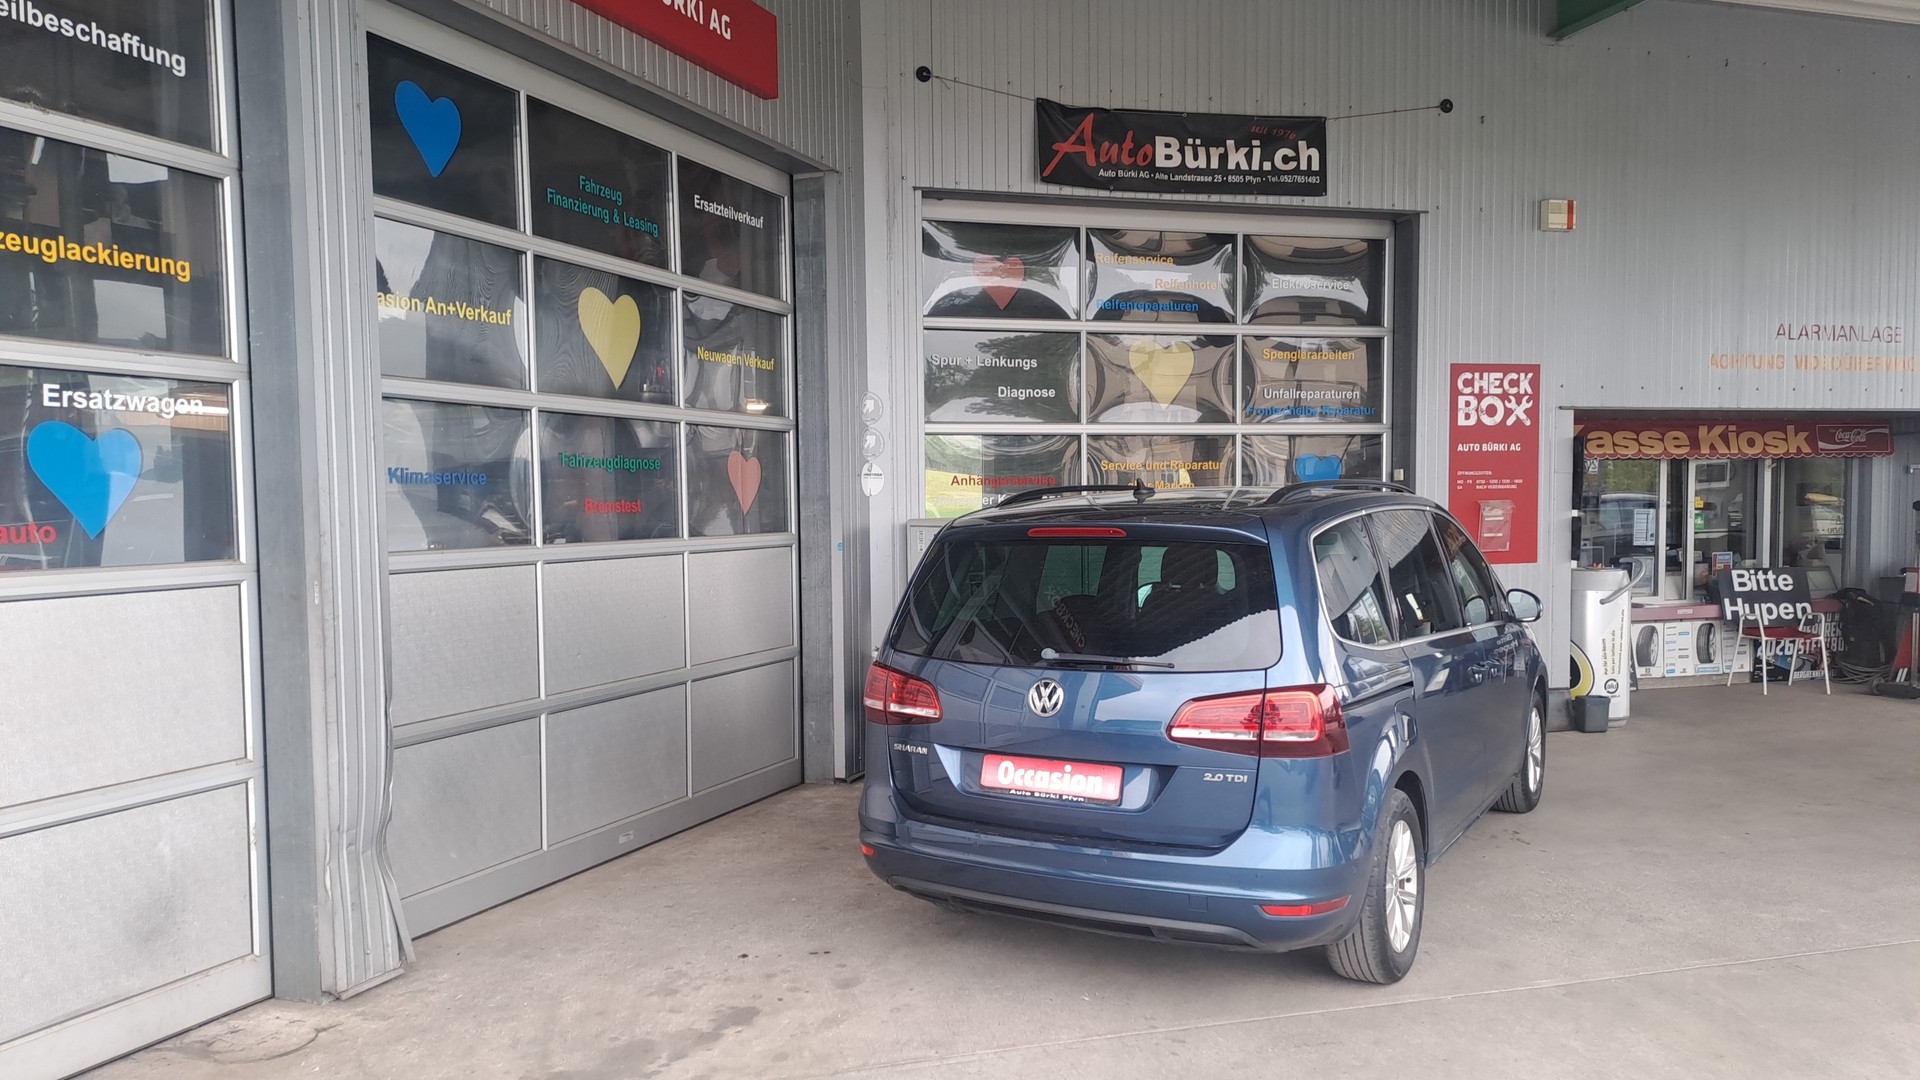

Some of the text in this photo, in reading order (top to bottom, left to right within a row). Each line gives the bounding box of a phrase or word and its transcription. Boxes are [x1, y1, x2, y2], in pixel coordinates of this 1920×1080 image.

[662, 0, 731, 40] RKI AG
[0, 0, 186, 77] eilbeschaffung
[1272, 128, 1297, 139] 1976
[1099, 168, 1116, 178] Auto
[1118, 169, 1138, 178] Bürki
[1139, 171, 1150, 179] AG
[1155, 172, 1168, 181] Alte
[1170, 173, 1212, 183] Landstrasse
[1214, 175, 1222, 183] 25
[1228, 175, 1243, 183] 8505
[1248, 176, 1261, 184] Pfyn
[579, 175, 622, 206] Fahrzeug
[546, 188, 659, 238] Finanzierung & Leasing
[694, 194, 764, 229] Ersatzteilverkauf
[1095, 253, 1174, 266] Reifenservice
[1155, 278, 1219, 290] Reifenhotel
[1272, 279, 1350, 291] Elektroservice
[425, 296, 512, 325] An+Verkauf
[1097, 299, 1198, 314] Reifenreparaturen
[1776, 323, 1902, 343] ALARMANLAGE
[697, 346, 775, 371] Neuwagen Verkauf
[931, 354, 1038, 370] Spur + Lenkungs
[1263, 349, 1355, 361] Spenglerarbeiten
[1709, 353, 1785, 370] ACHTUNG
[1457, 372, 1533, 394] CHECK
[42, 383, 203, 419] Ersatzwagen
[998, 386, 1056, 400] Diagnose
[1264, 388, 1360, 401] Unfallreparaturen
[1457, 395, 1533, 426] BOX
[1457, 441, 1521, 452] AUTO BÜRKI AG
[1699, 424, 1812, 455] Kiosk
[561, 452, 661, 472] Fahrzeugdiagnose
[1101, 460, 1224, 472] Service und Reparatur
[387, 467, 487, 487] Klimaservice
[951, 475, 1056, 488] Anhängerservice
[584, 498, 642, 514] Bremstest
[1731, 569, 1794, 592] Bitte
[1724, 597, 1813, 626] Hupen
[893, 743, 928, 755] SHARAN
[997, 760, 1103, 794] Occasion
[1203, 773, 1248, 783] 2.0 TDI
